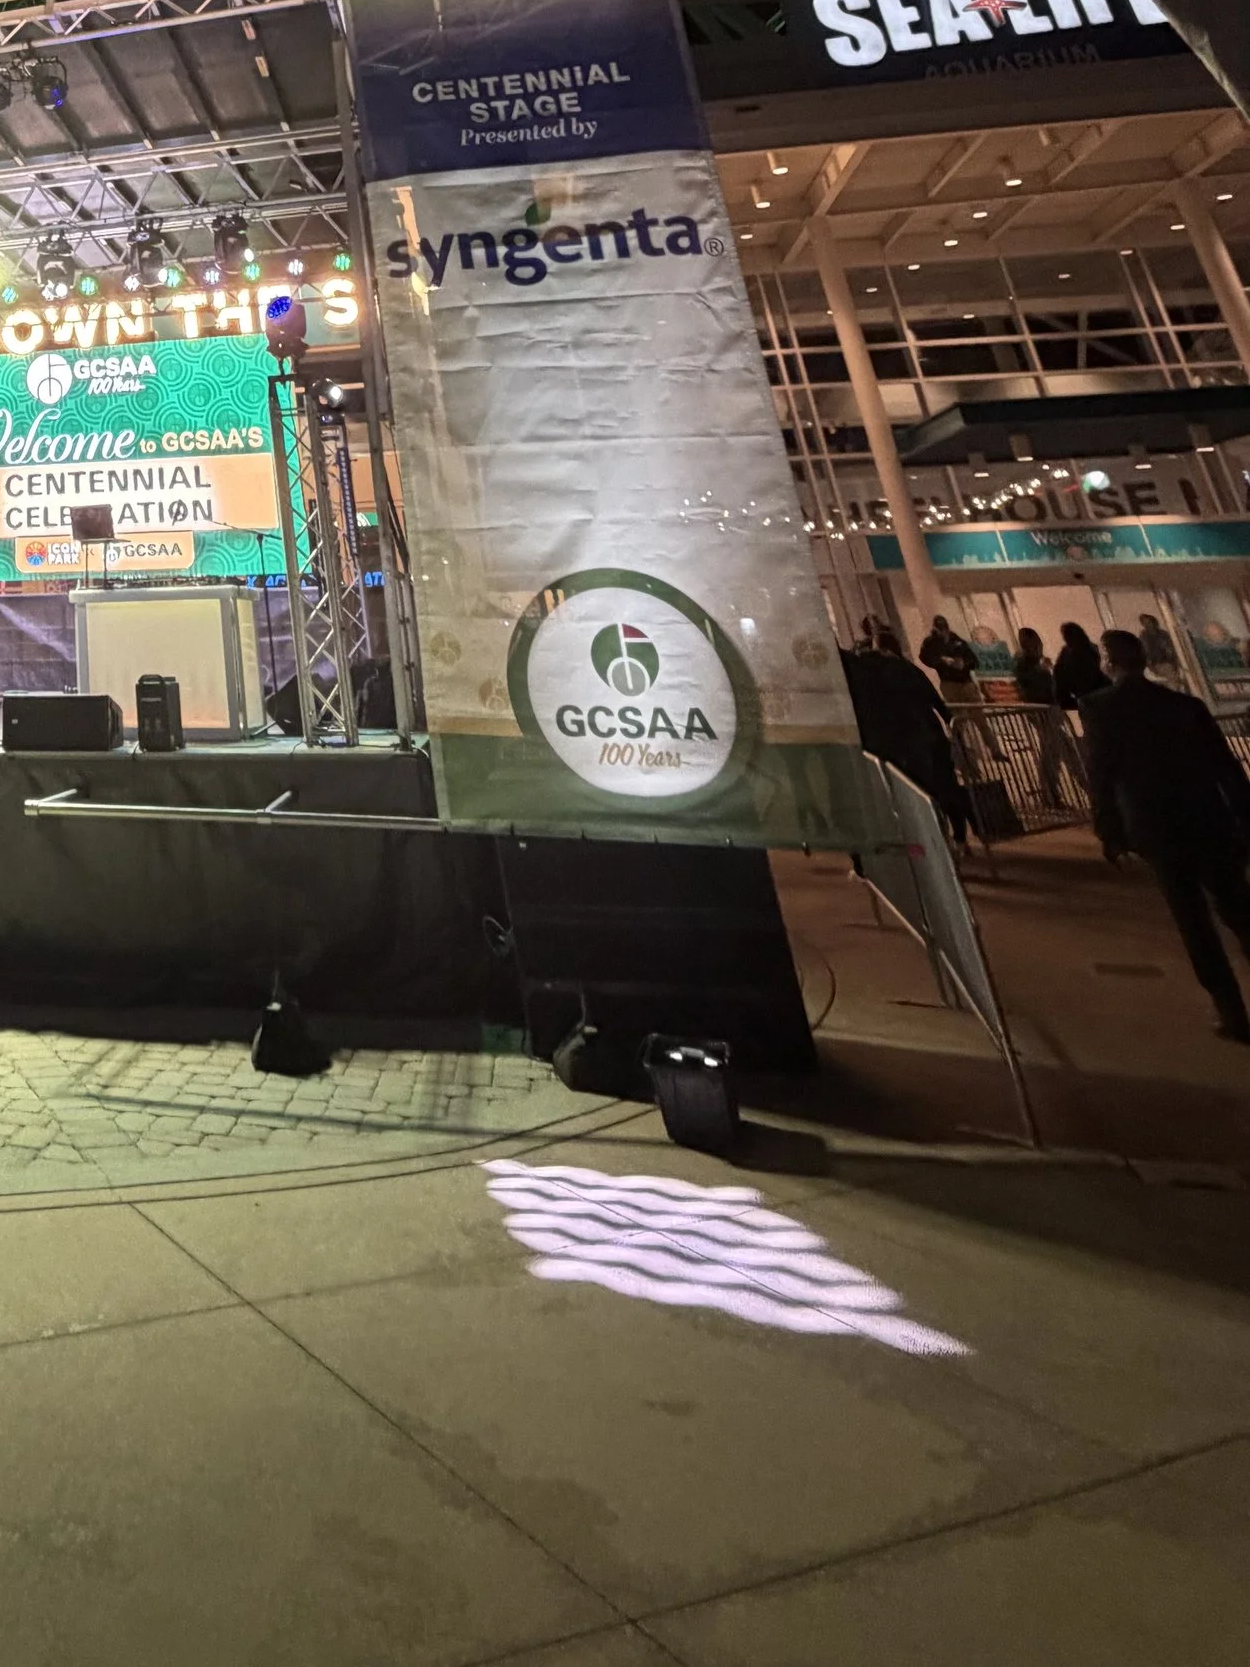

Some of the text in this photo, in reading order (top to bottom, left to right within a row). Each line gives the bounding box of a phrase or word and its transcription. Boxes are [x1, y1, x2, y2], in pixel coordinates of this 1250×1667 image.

[925, 43, 1100, 79] AQUARIUM
[412, 61, 630, 103] CENTENNIAL
[470, 92, 582, 124] STAGE
[461, 117, 598, 146] Presented by
[0, 298, 148, 354] OWN
[74, 355, 156, 379] GCSAA
[88, 377, 112, 395] 100
[140, 439, 156, 453] to
[162, 426, 263, 452] GCSAA'S
[5, 465, 211, 498] CENTENNIAL
[5, 499, 213, 530] CELEATION
[47, 541, 79, 555] ICON
[47, 554, 80, 566] PARK
[124, 543, 183, 557] GCSAA
[555, 704, 719, 741] GCSAA
[600, 743, 692, 769] 100 Years
